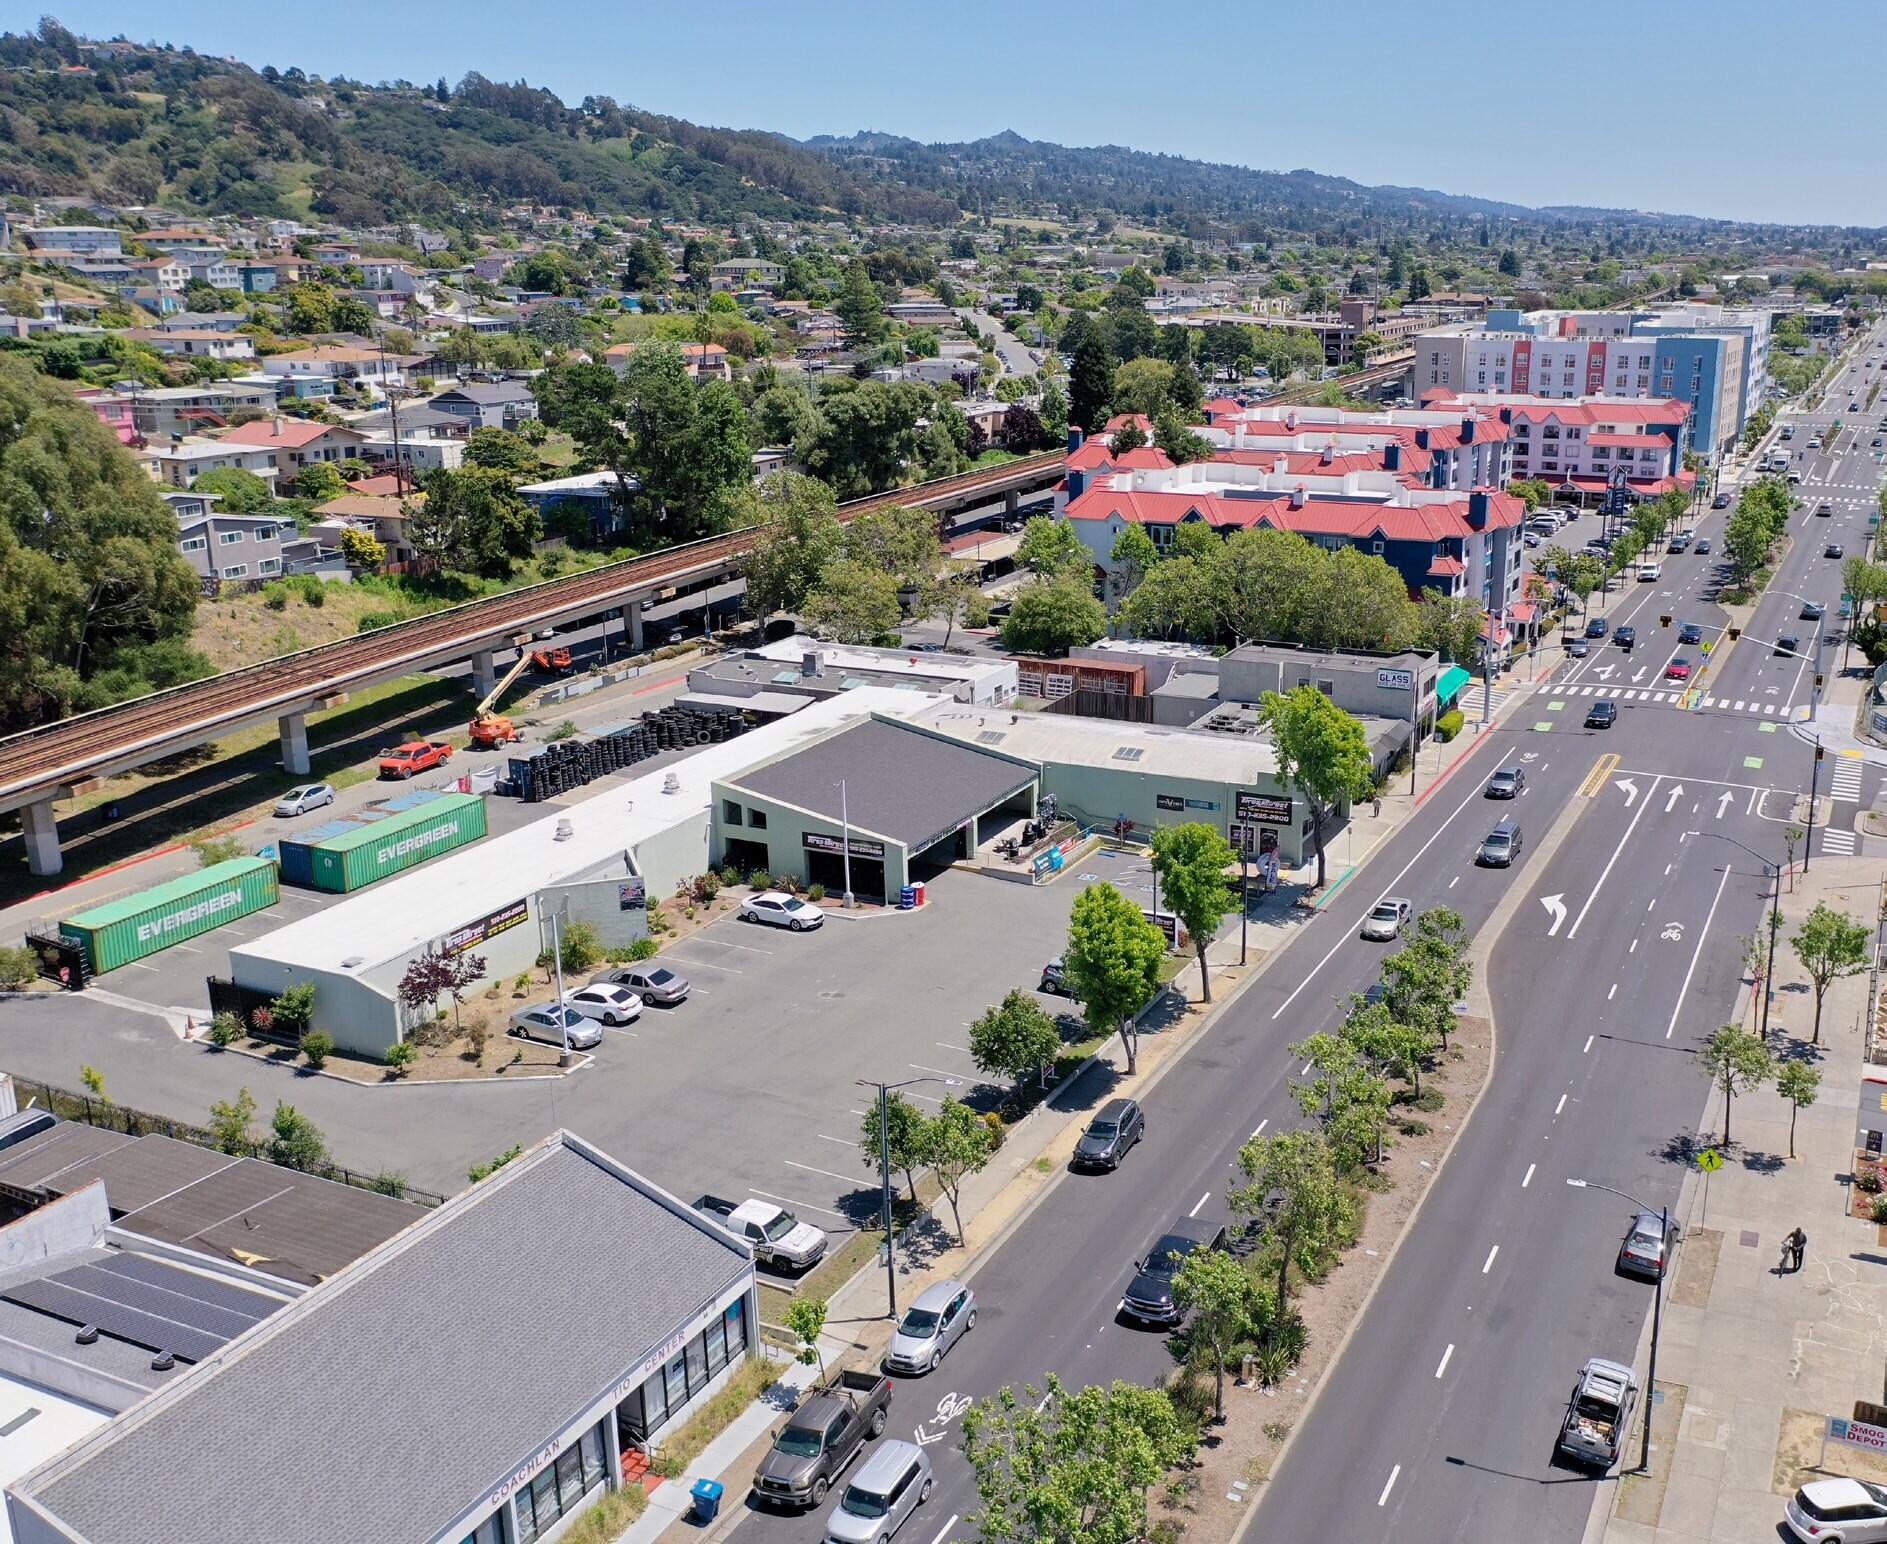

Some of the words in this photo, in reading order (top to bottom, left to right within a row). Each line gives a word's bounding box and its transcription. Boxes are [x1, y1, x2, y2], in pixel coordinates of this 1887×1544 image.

[1379, 673, 1409, 684] GLASS
[377, 820, 458, 864] EVERGREEN
[824, 838, 846, 848] Direc
[1269, 862, 1277, 884] SALE
[137, 888, 242, 942] EVERGREEN
[491, 1437, 561, 1505] COACHLAN
[612, 1377, 631, 1400] TIO
[644, 1330, 686, 1372] CENTER
[1847, 1431, 1887, 1448] DEPOT
[1850, 1423, 1885, 1439] SMOG
